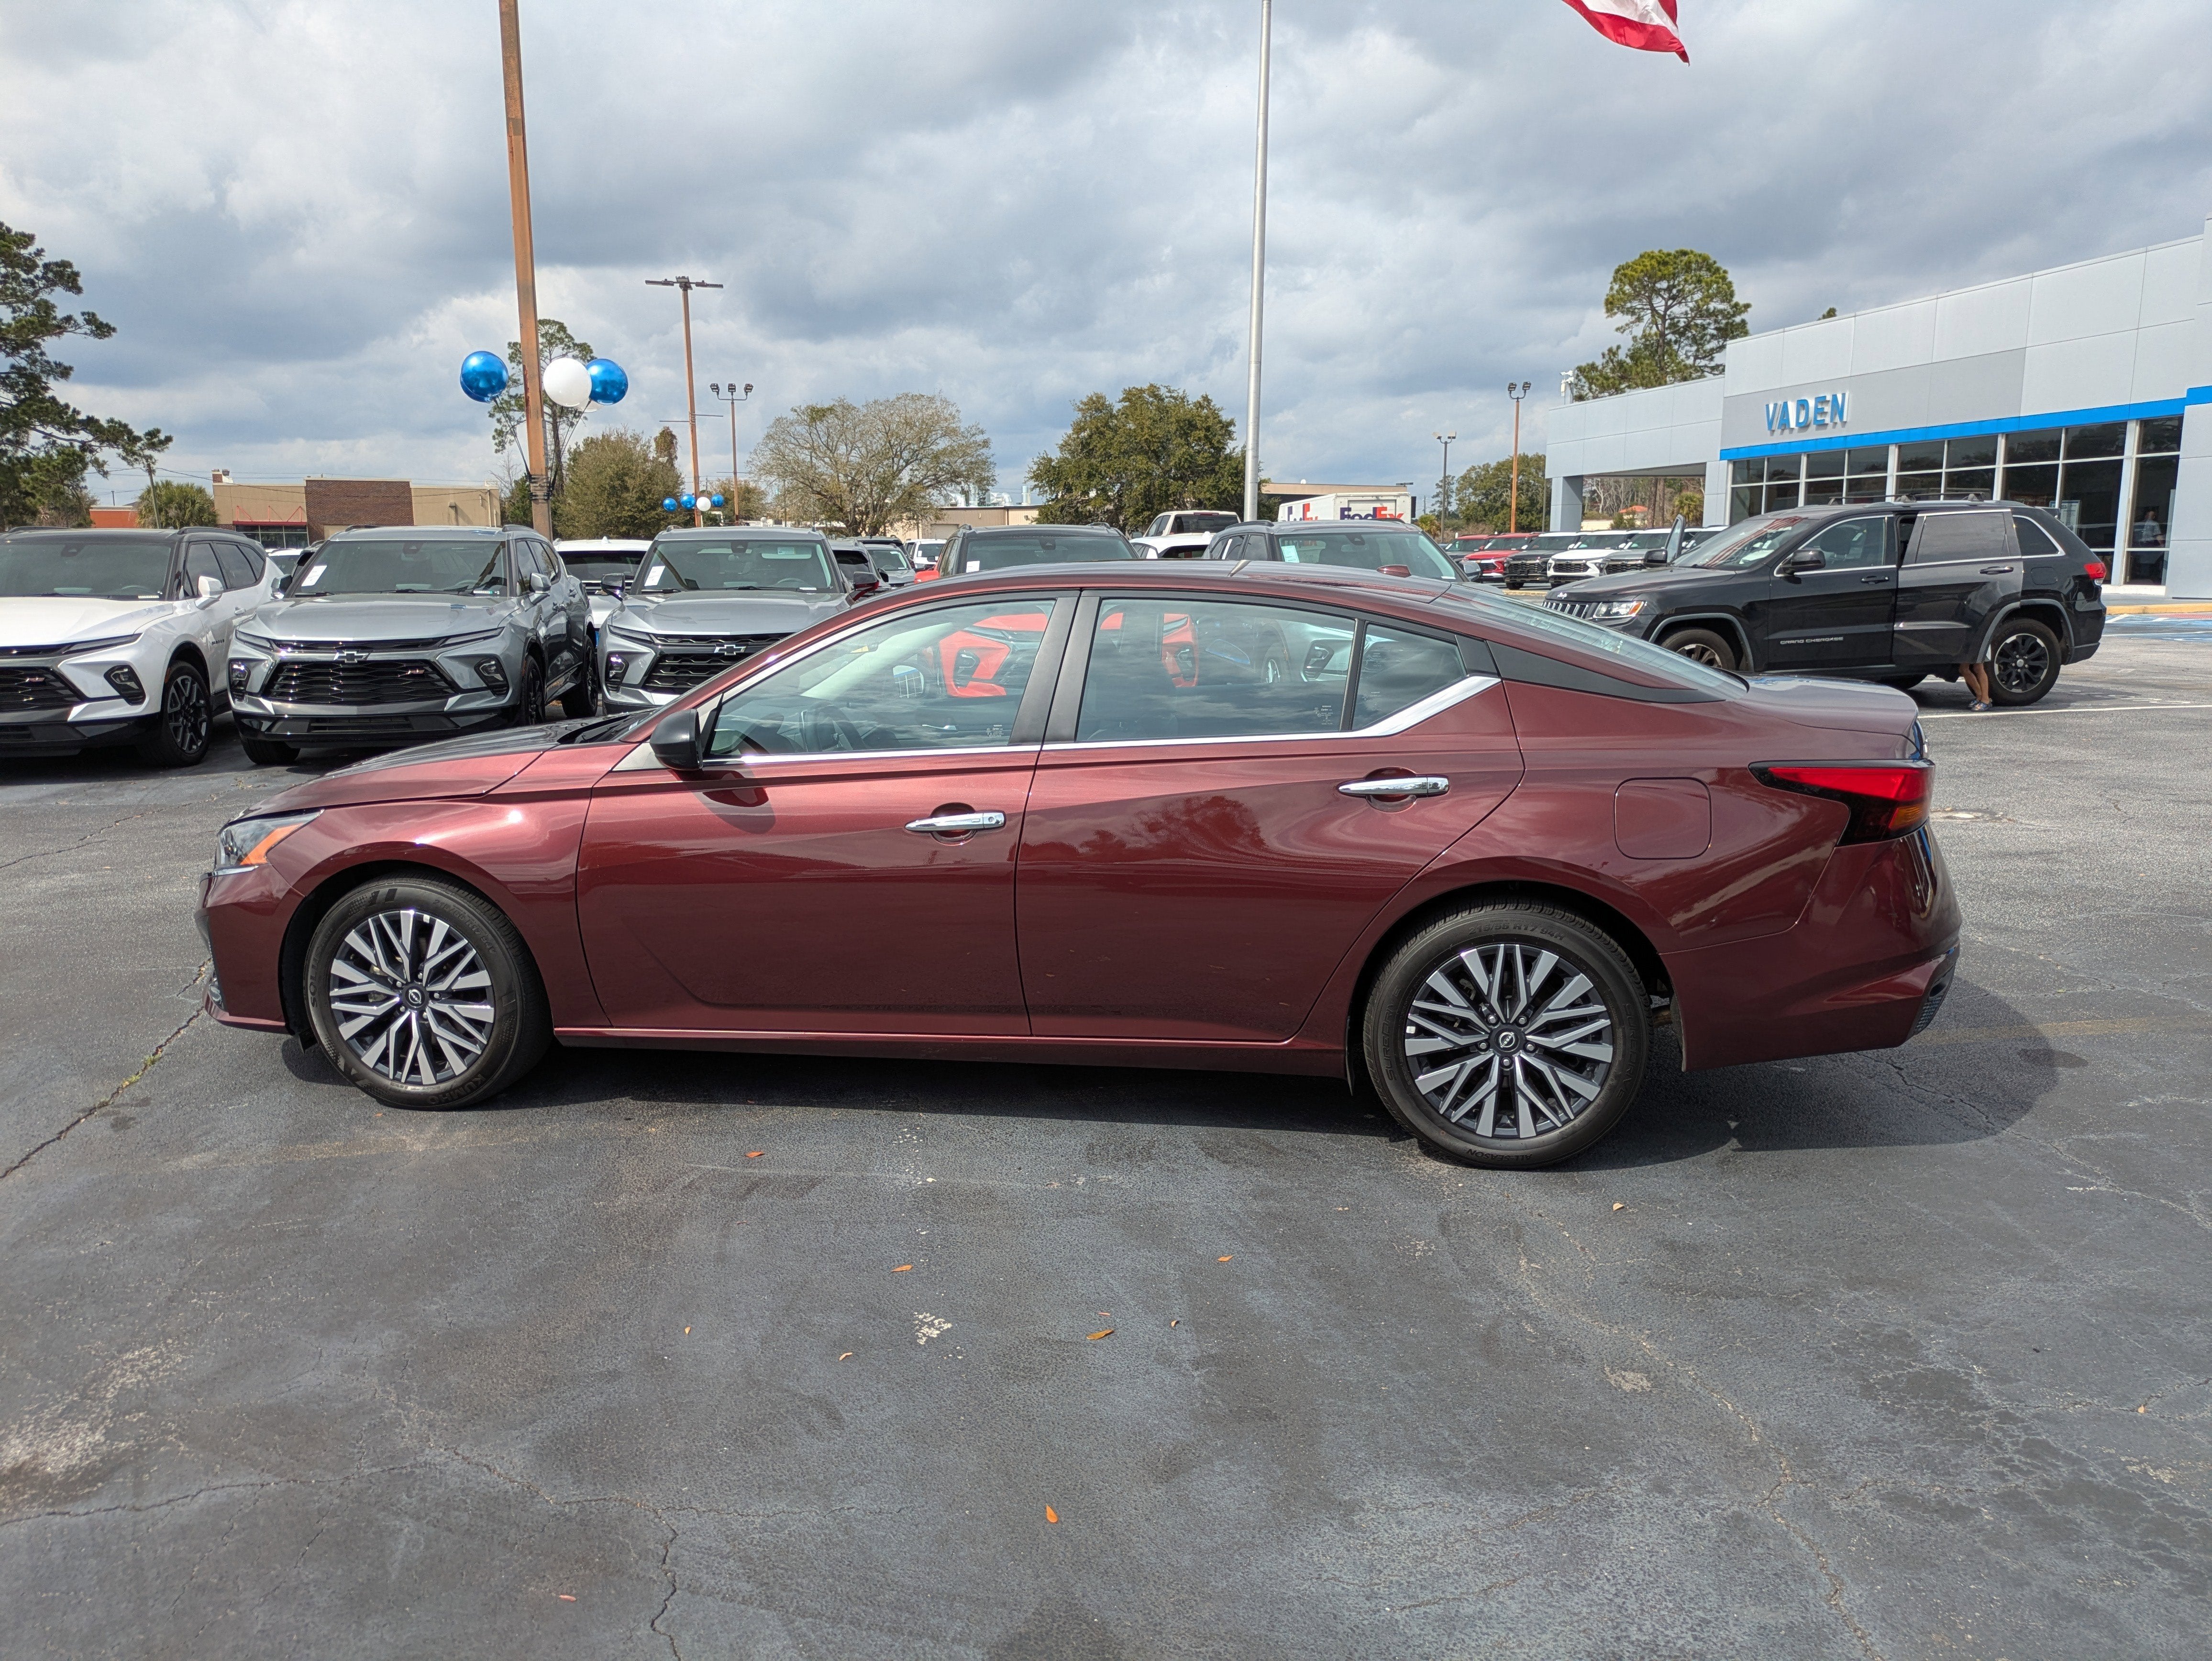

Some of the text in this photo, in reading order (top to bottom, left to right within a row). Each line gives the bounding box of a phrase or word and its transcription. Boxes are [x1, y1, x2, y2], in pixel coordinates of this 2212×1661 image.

[1765, 392, 1847, 431] VADEN
[430, 1073, 487, 1105] KUMHO
[1466, 1148, 1533, 1162] ALL-SEASON
